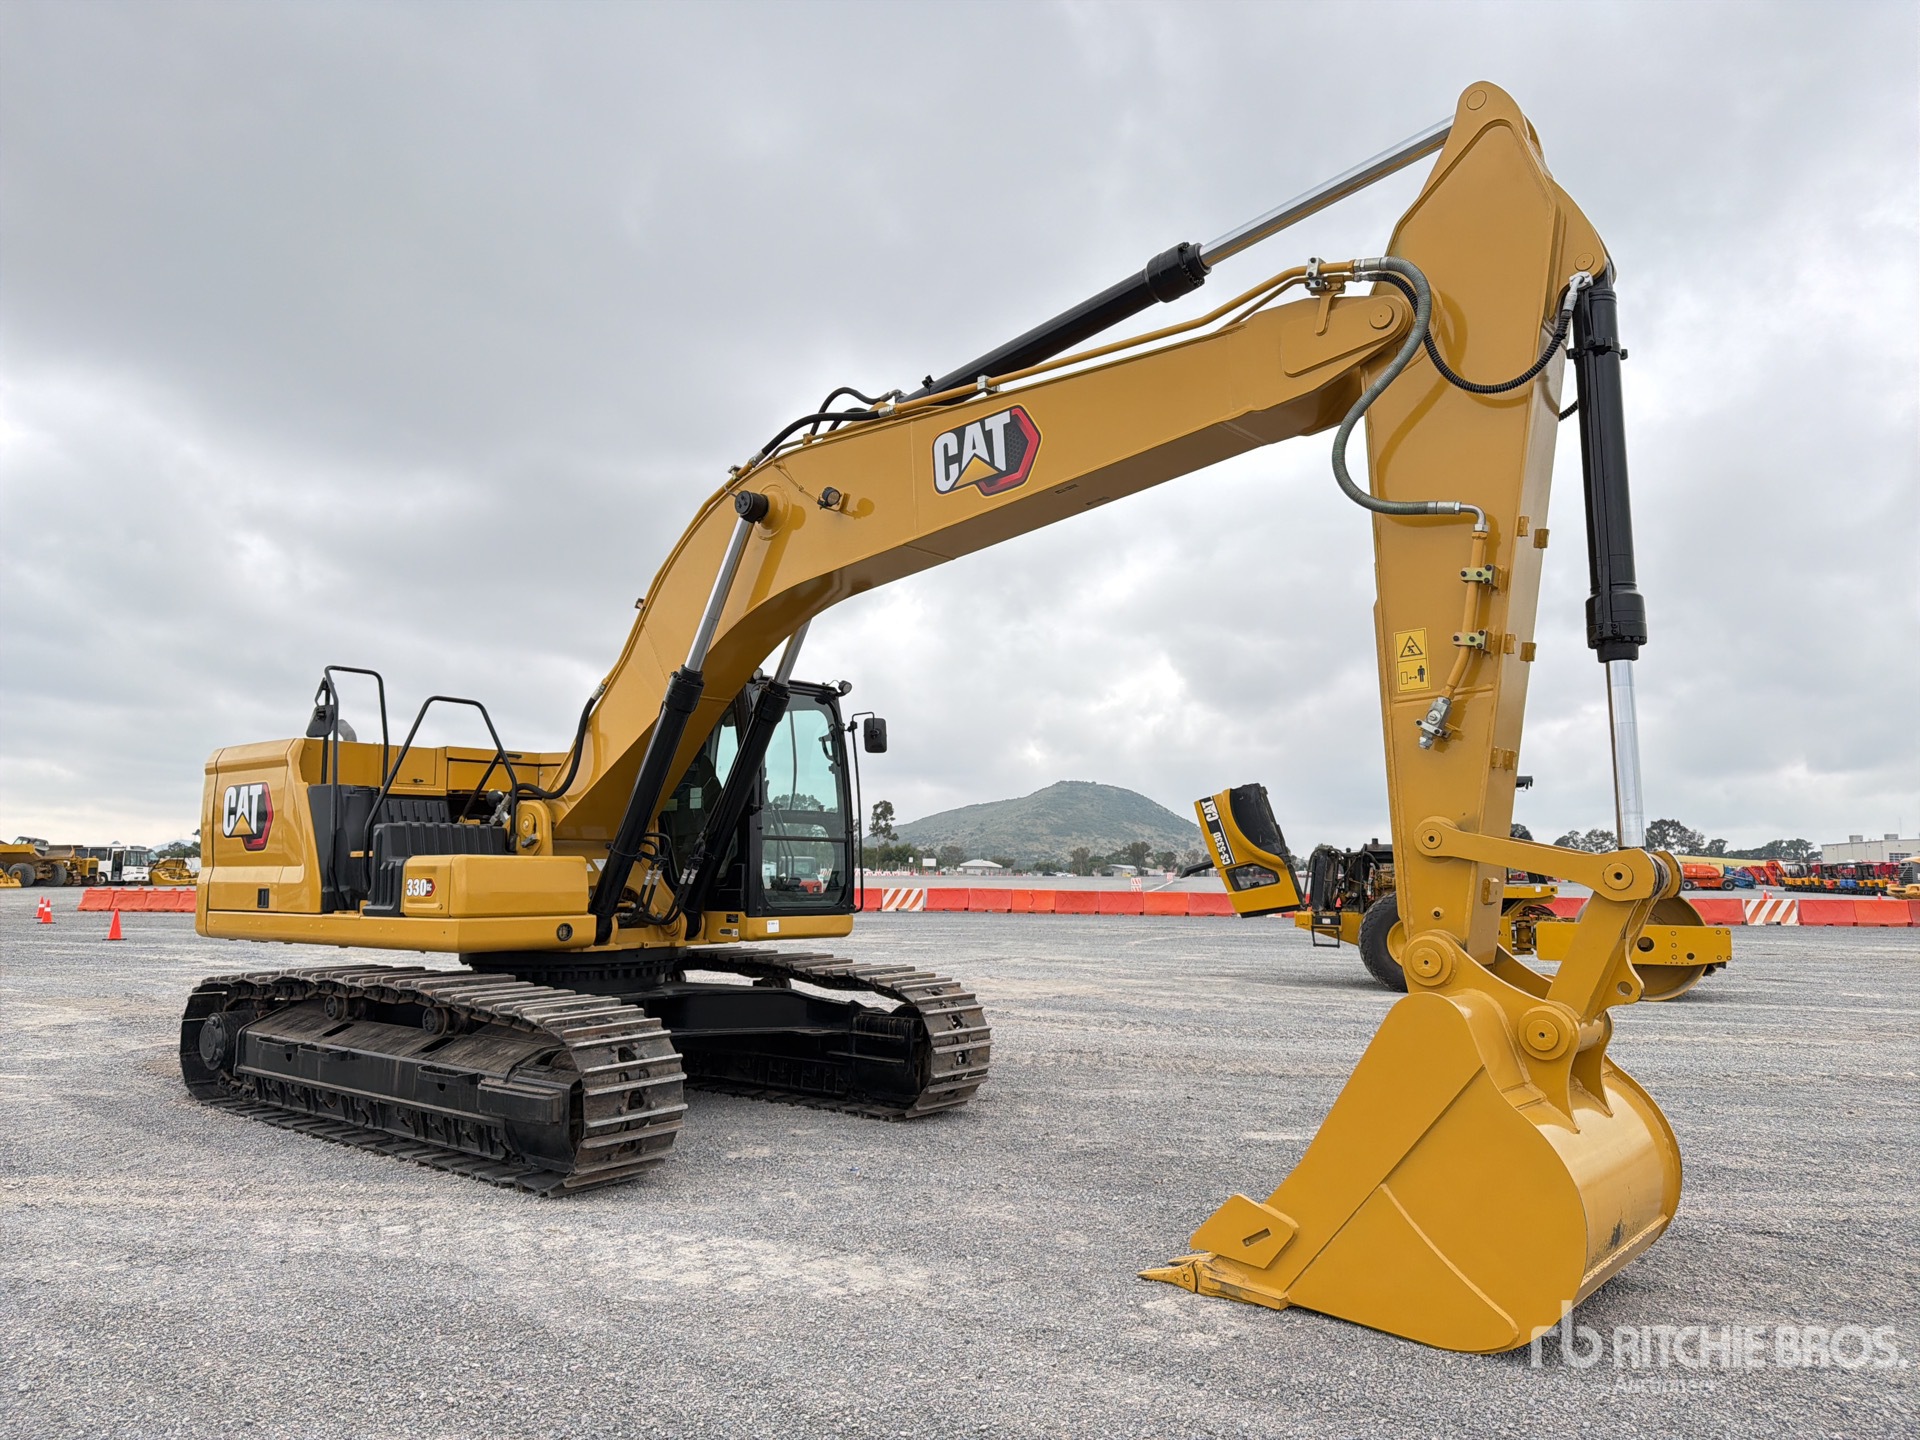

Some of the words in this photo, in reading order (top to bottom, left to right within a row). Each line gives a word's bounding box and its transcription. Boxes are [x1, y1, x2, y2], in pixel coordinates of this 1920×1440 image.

[933, 410, 1011, 492] CAT
[223, 784, 263, 836] CAT
[1200, 800, 1219, 822] CAT
[406, 878, 427, 896] 330
